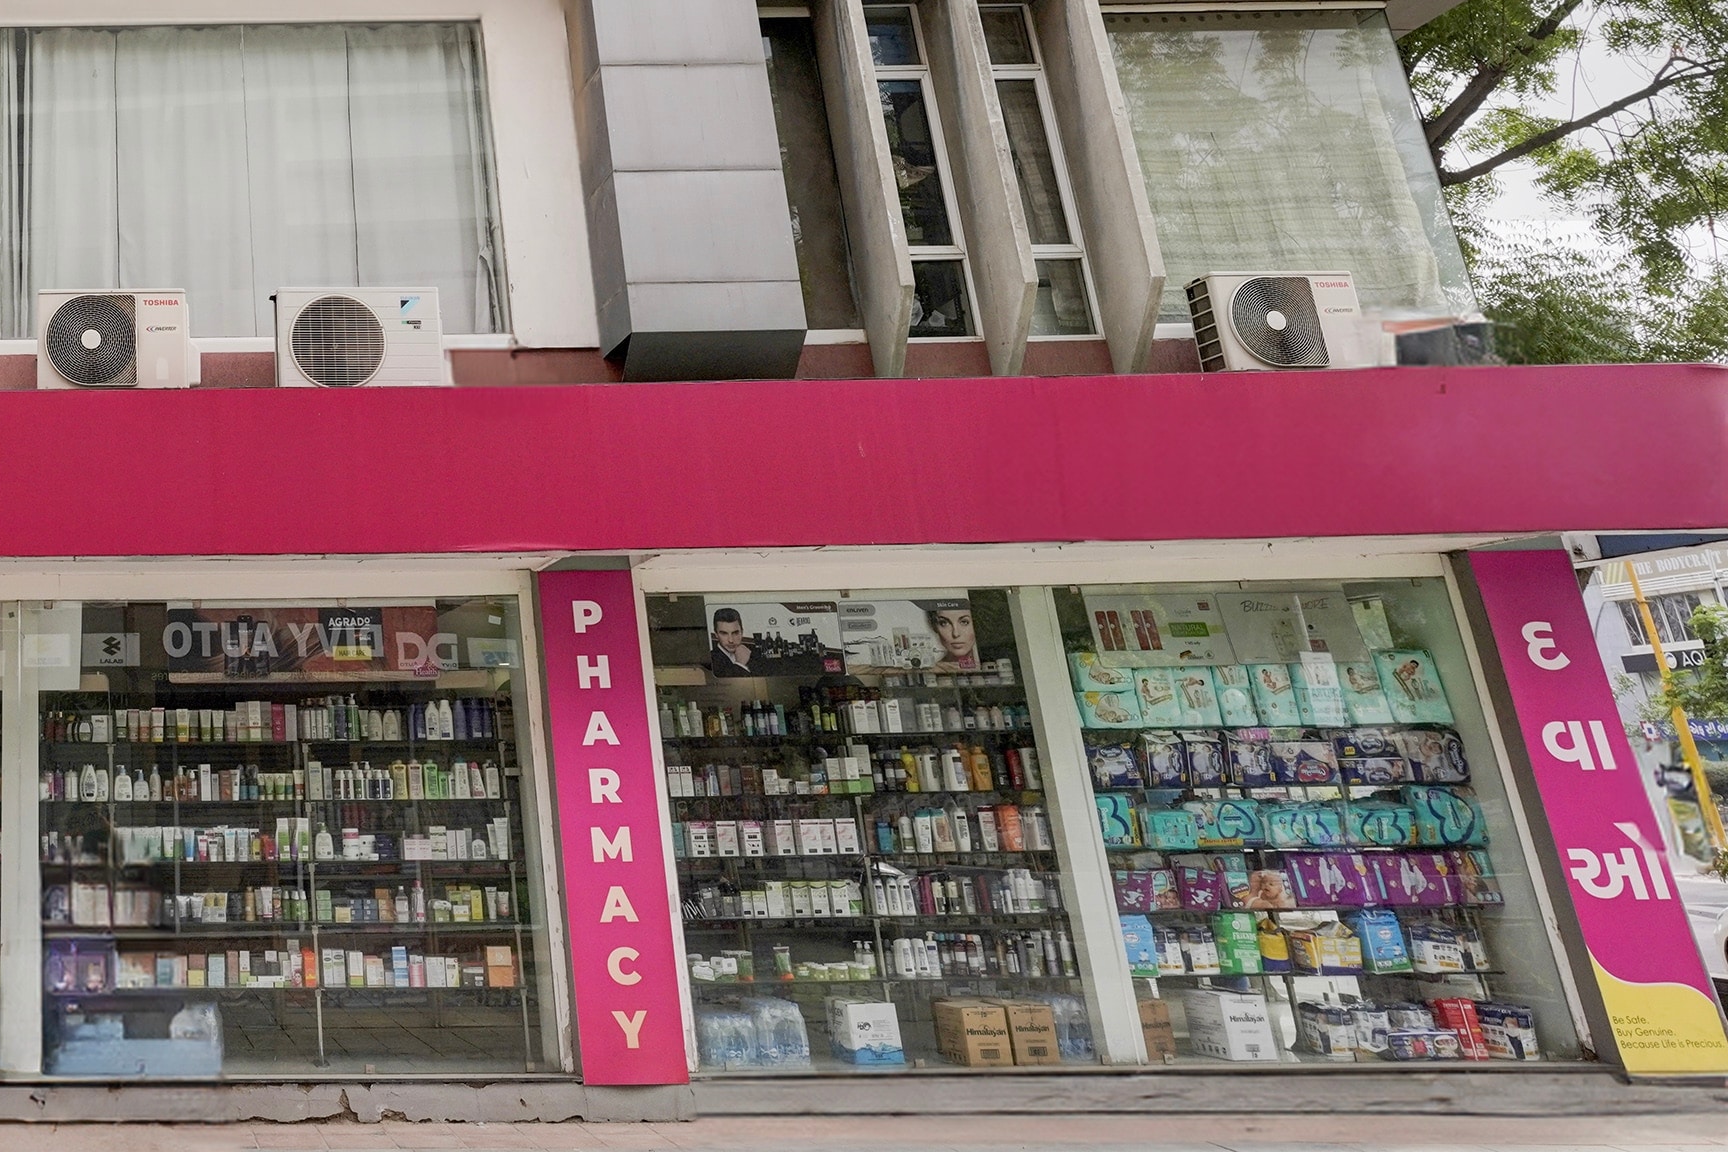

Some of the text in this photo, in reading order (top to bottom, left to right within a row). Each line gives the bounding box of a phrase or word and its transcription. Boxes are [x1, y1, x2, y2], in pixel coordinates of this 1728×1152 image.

[1314, 281, 1350, 289] TOSHIBA
[142, 299, 180, 307] TOSHIBA
[572, 600, 648, 1049] PHARMACY
[1229, 1012, 1266, 1025] Himalayan
[1612, 1016, 1624, 1025] Be
[966, 1025, 1007, 1038] Himalayan
[1015, 1023, 1050, 1035] Himalayan
[1616, 1028, 1632, 1038] Buy
[1620, 1040, 1660, 1049] Because
[1661, 1040, 1677, 1048] Life
